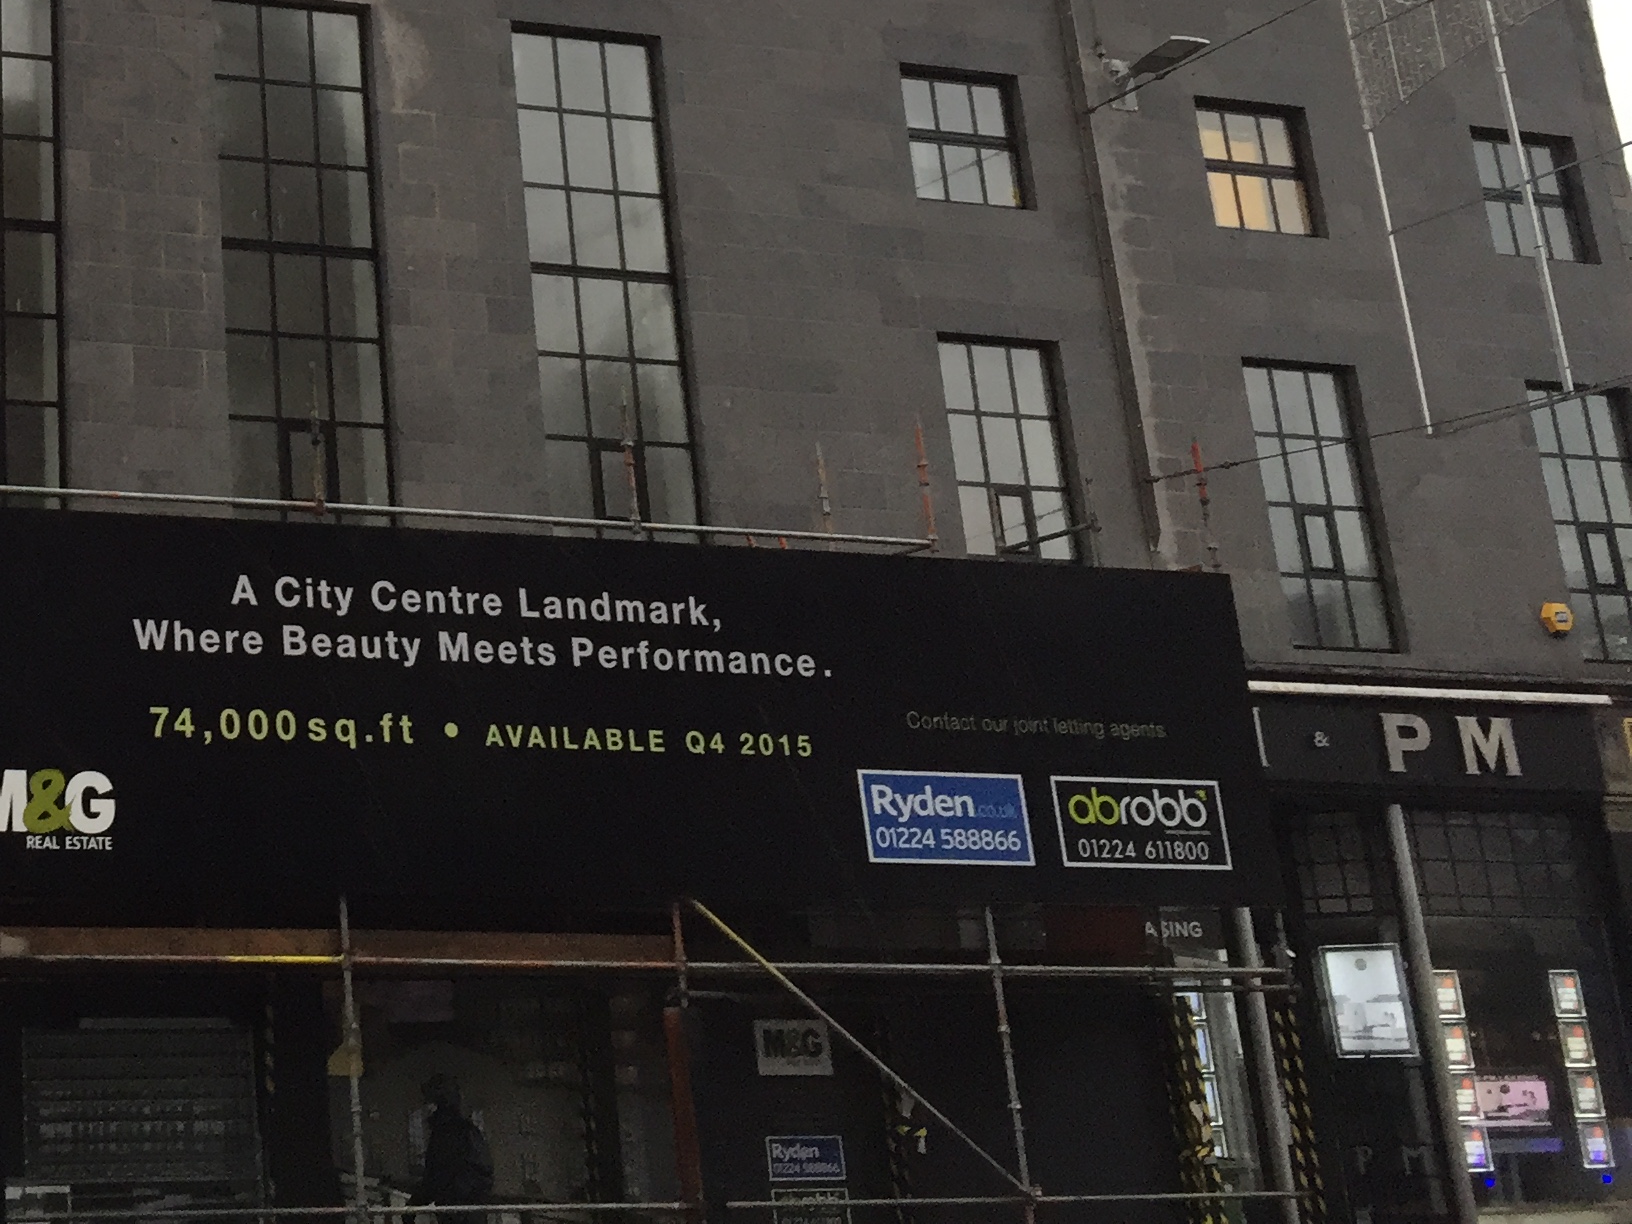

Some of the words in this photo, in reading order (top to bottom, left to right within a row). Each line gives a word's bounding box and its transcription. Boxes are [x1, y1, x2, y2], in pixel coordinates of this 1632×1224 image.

[230, 574, 259, 606] A
[274, 575, 354, 617] City
[370, 580, 504, 617] Centre
[518, 586, 722, 633] Landmark,
[132, 618, 264, 655] Where
[282, 624, 421, 668] Beauty
[437, 630, 557, 667] Meets
[570, 636, 833, 678] Performance.
[484, 723, 666, 754] AVAILABLE
[684, 729, 726, 756] Q4
[739, 731, 813, 758] 2015
[905, 709, 977, 732] Contact
[981, 717, 1009, 733] our
[1012, 716, 1049, 737] joint
[1052, 716, 1105, 740] letting
[1109, 721, 1167, 741] agents
[1313, 730, 1332, 749] &
[1068, 786, 1208, 828] abrobb
[25, 835, 61, 851] REAL
[64, 836, 114, 852] ESTATE
[875, 826, 937, 849] 01224
[940, 828, 1023, 852] 588866
[1077, 837, 1137, 859] 01224
[1144, 839, 1210, 861] 611800
